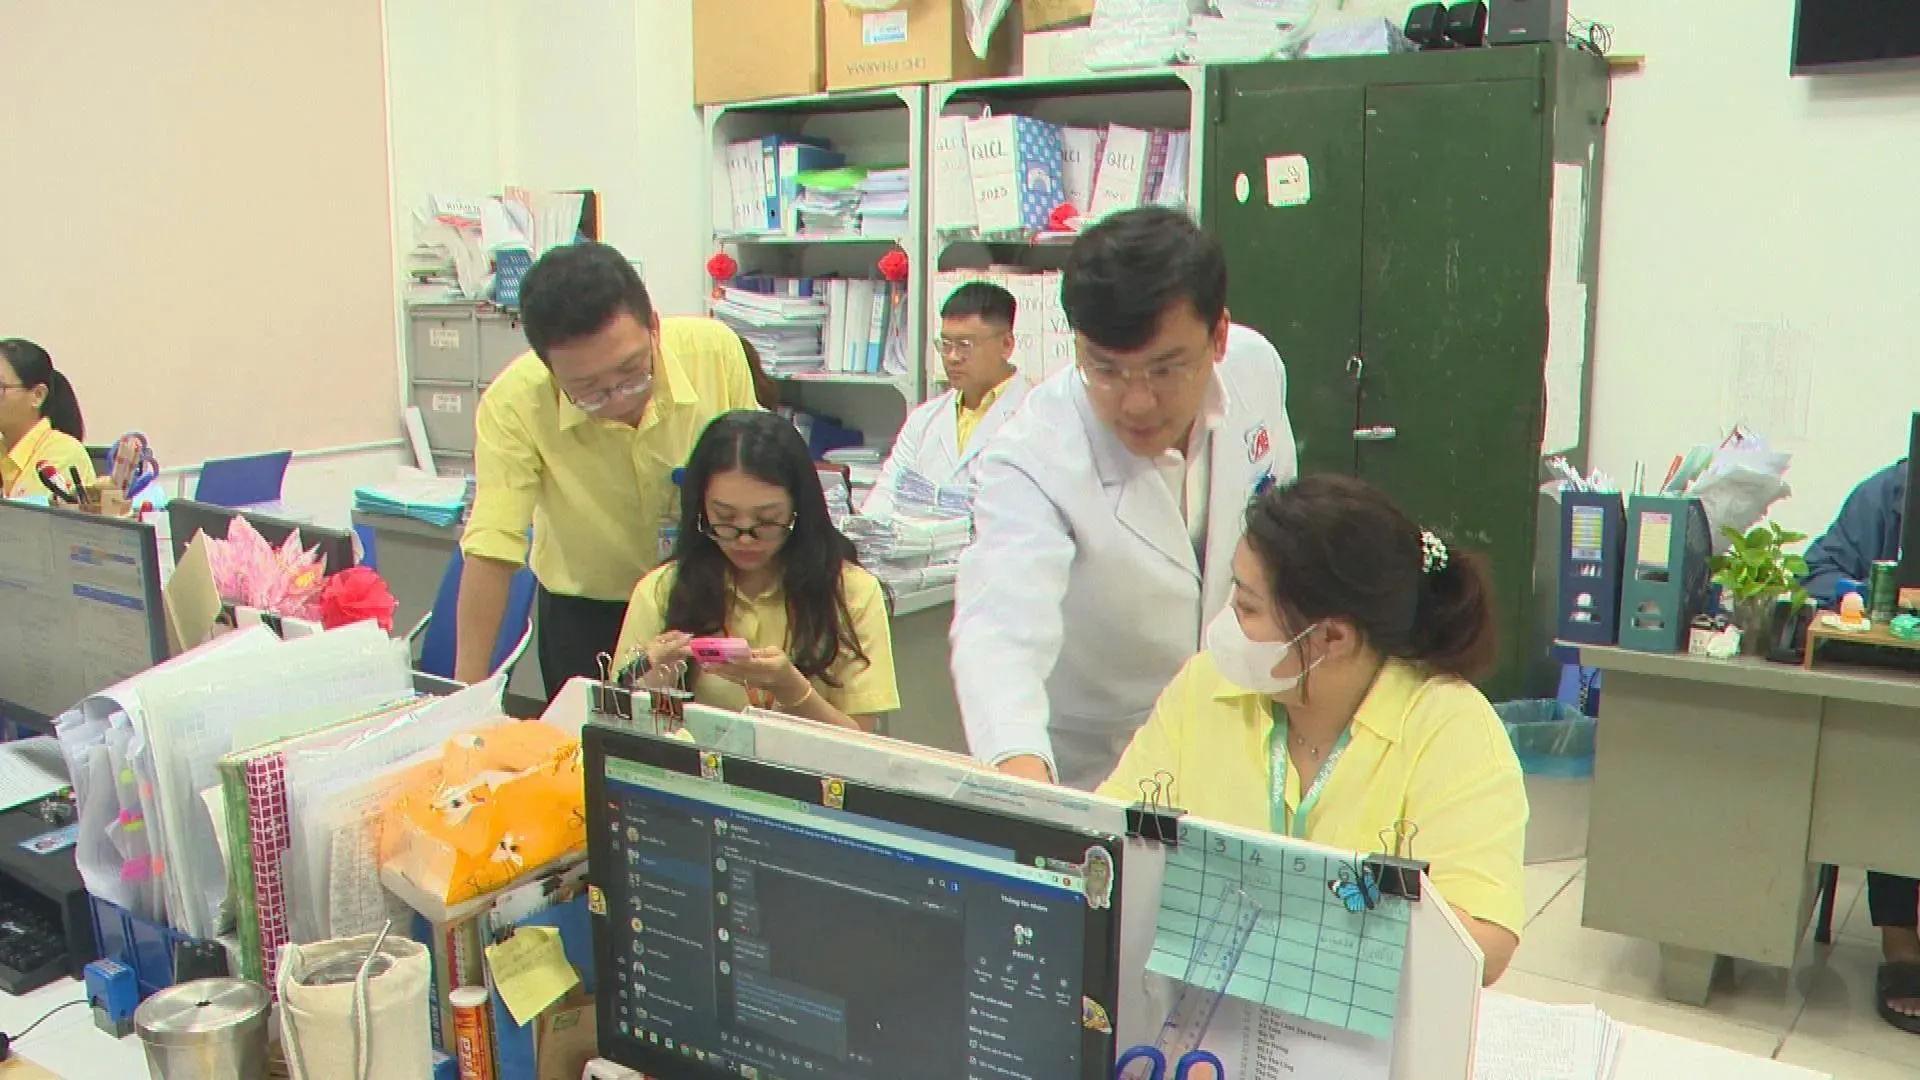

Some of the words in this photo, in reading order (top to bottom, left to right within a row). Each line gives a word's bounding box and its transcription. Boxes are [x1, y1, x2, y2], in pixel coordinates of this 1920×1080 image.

[1179, 827, 1189, 842] 2
[1213, 837, 1227, 853] 3
[1250, 849, 1264, 866] 4
[1293, 857, 1306, 873] 5
